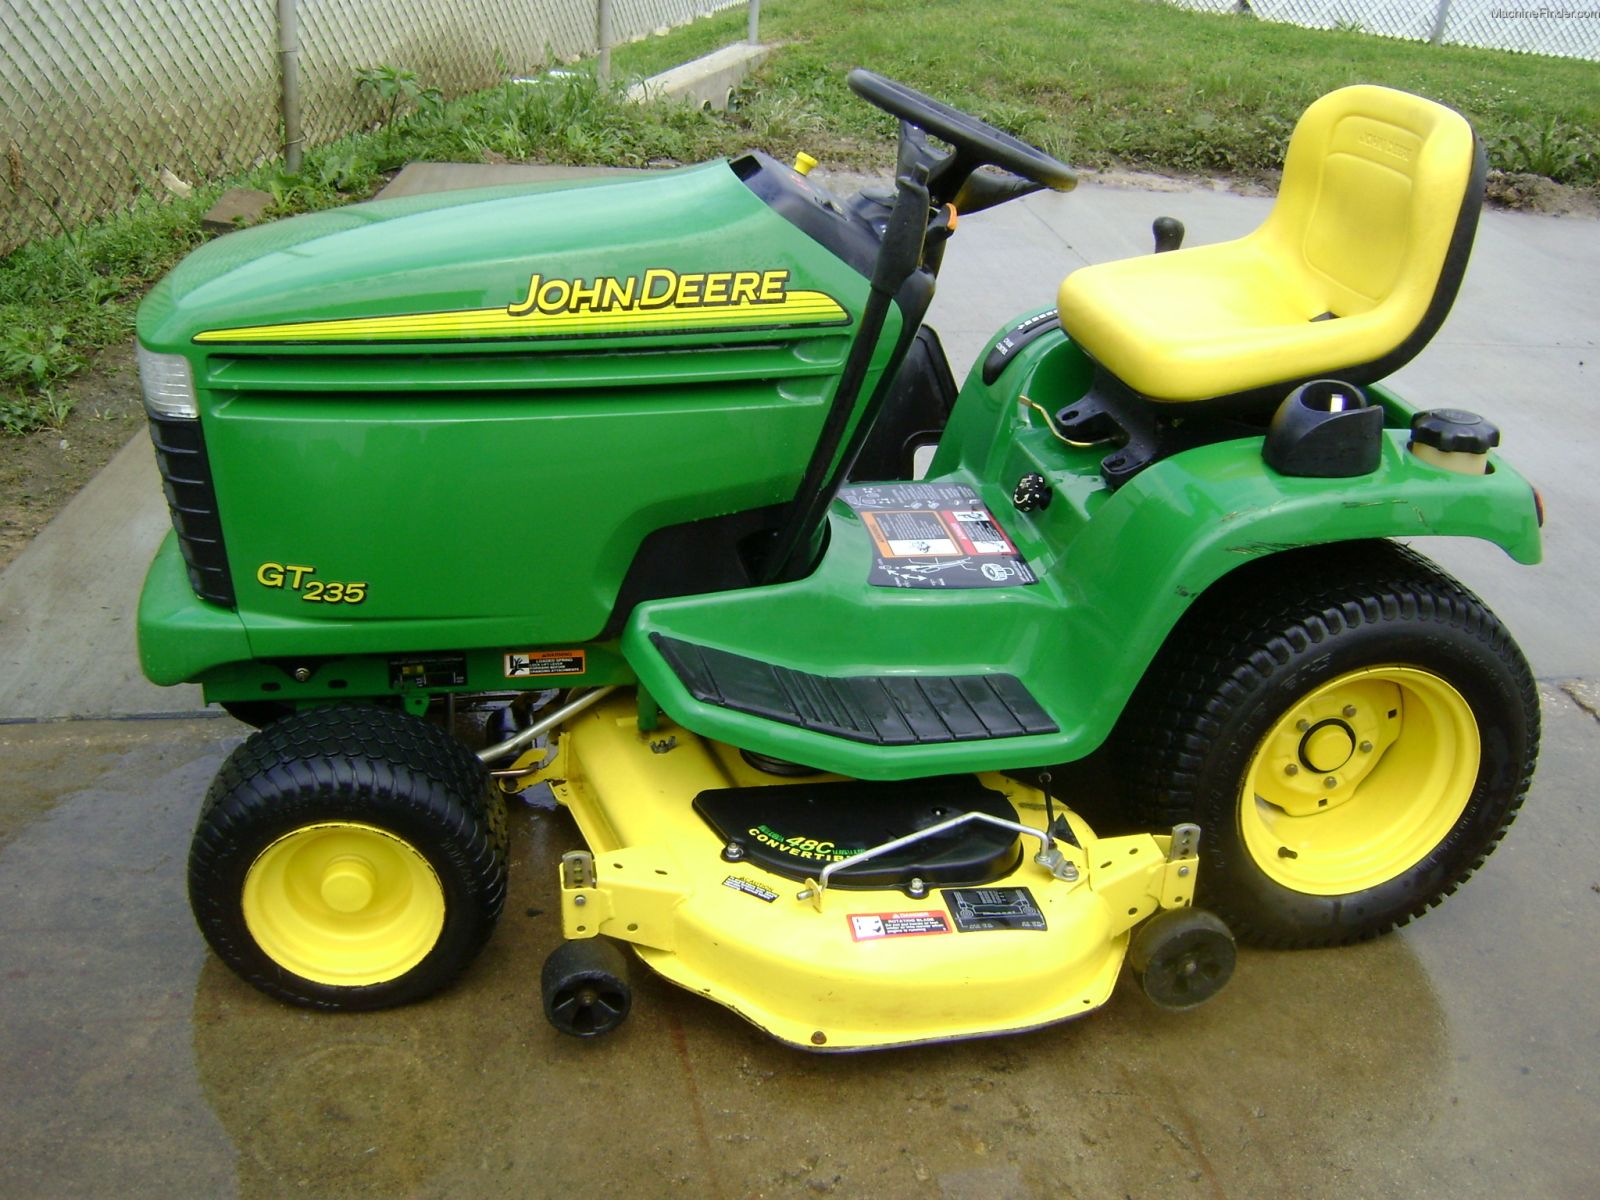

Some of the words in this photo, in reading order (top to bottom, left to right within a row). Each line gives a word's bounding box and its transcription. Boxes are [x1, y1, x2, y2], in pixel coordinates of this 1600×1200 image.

[508, 274, 637, 317] JOHN
[637, 268, 789, 311] DEERE
[748, 828, 869, 862] CONVERTIB
[786, 836, 835, 854] 48C
